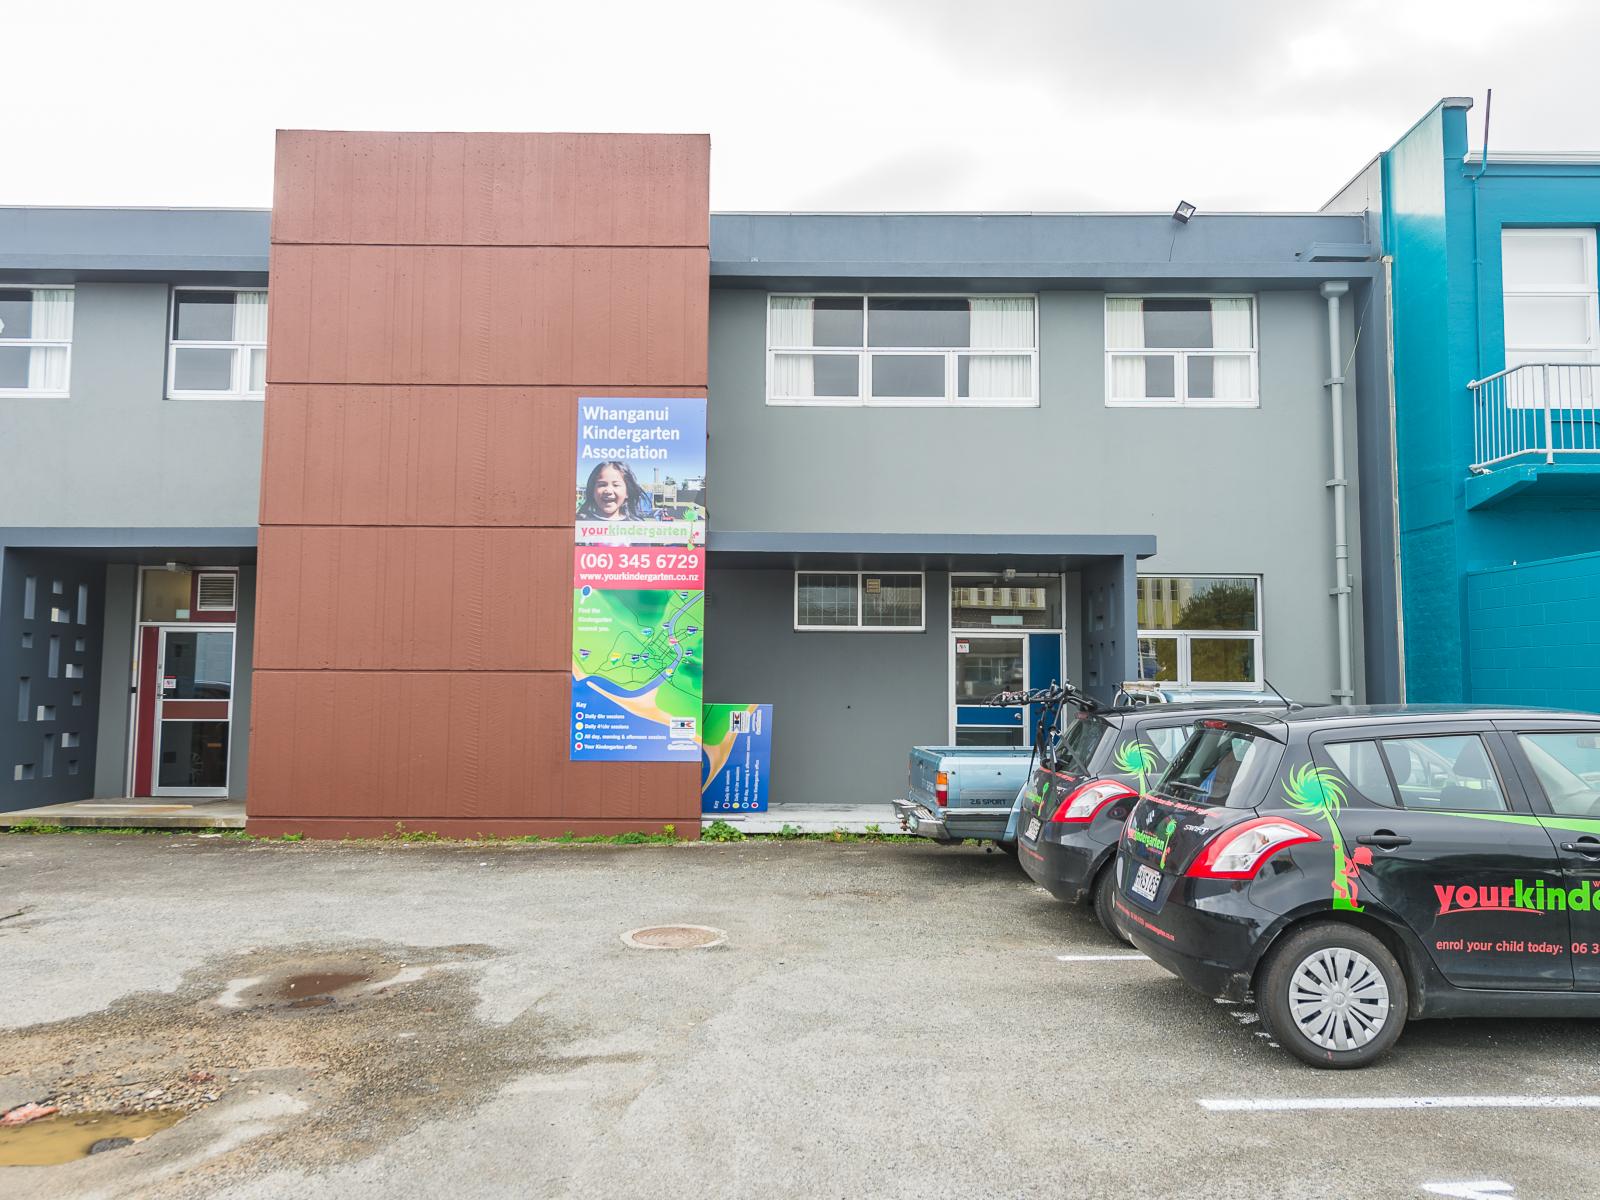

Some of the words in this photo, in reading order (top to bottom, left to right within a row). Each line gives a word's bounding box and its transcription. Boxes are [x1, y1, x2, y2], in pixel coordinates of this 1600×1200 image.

[583, 406, 669, 424] Whanganui
[583, 425, 680, 443] Kindergarten
[581, 444, 668, 460] Association
[581, 525, 688, 538] yourkindergarten
[580, 553, 613, 570] (06)
[619, 554, 651, 569] 345
[656, 554, 699, 569] 6729
[580, 571, 699, 582] www.yourkindergarten.co.nz
[576, 701, 587, 709] Key
[1436, 939, 1464, 951] enrol
[1466, 941, 1492, 953] your
[1496, 940, 1524, 952] child
[1528, 942, 1563, 955] today:
[1571, 942, 1588, 954] 06
